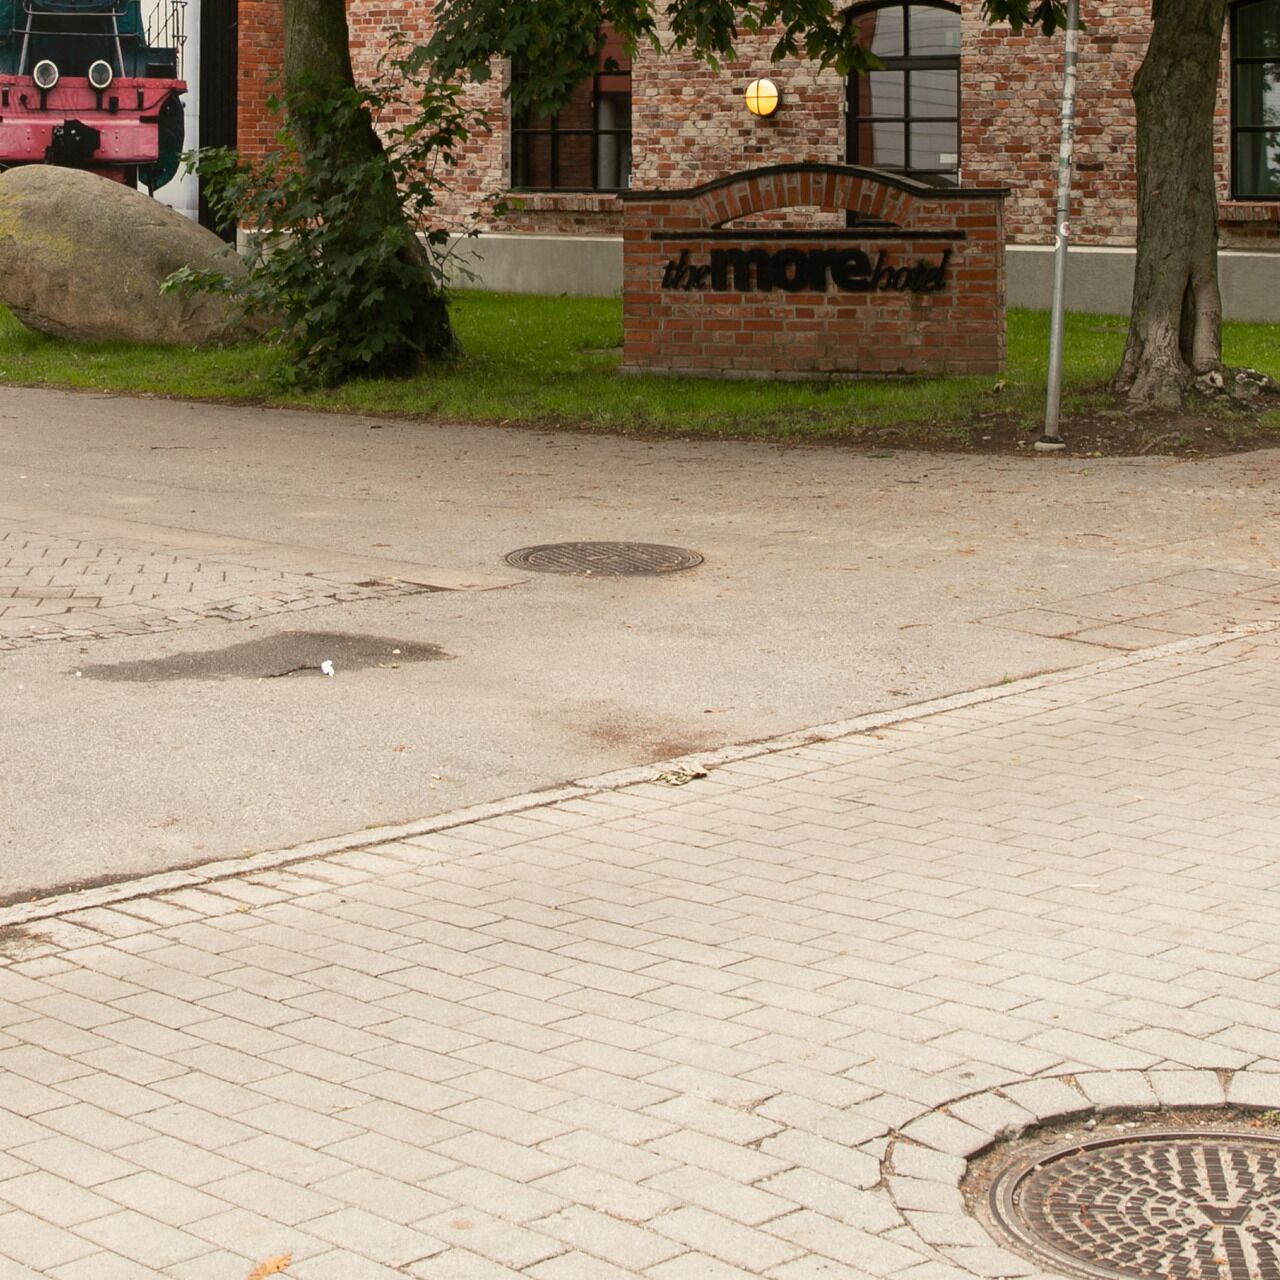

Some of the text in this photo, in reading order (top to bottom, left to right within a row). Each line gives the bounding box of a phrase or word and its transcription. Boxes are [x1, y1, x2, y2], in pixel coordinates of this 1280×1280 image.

[661, 247, 952, 292] the more hotel
